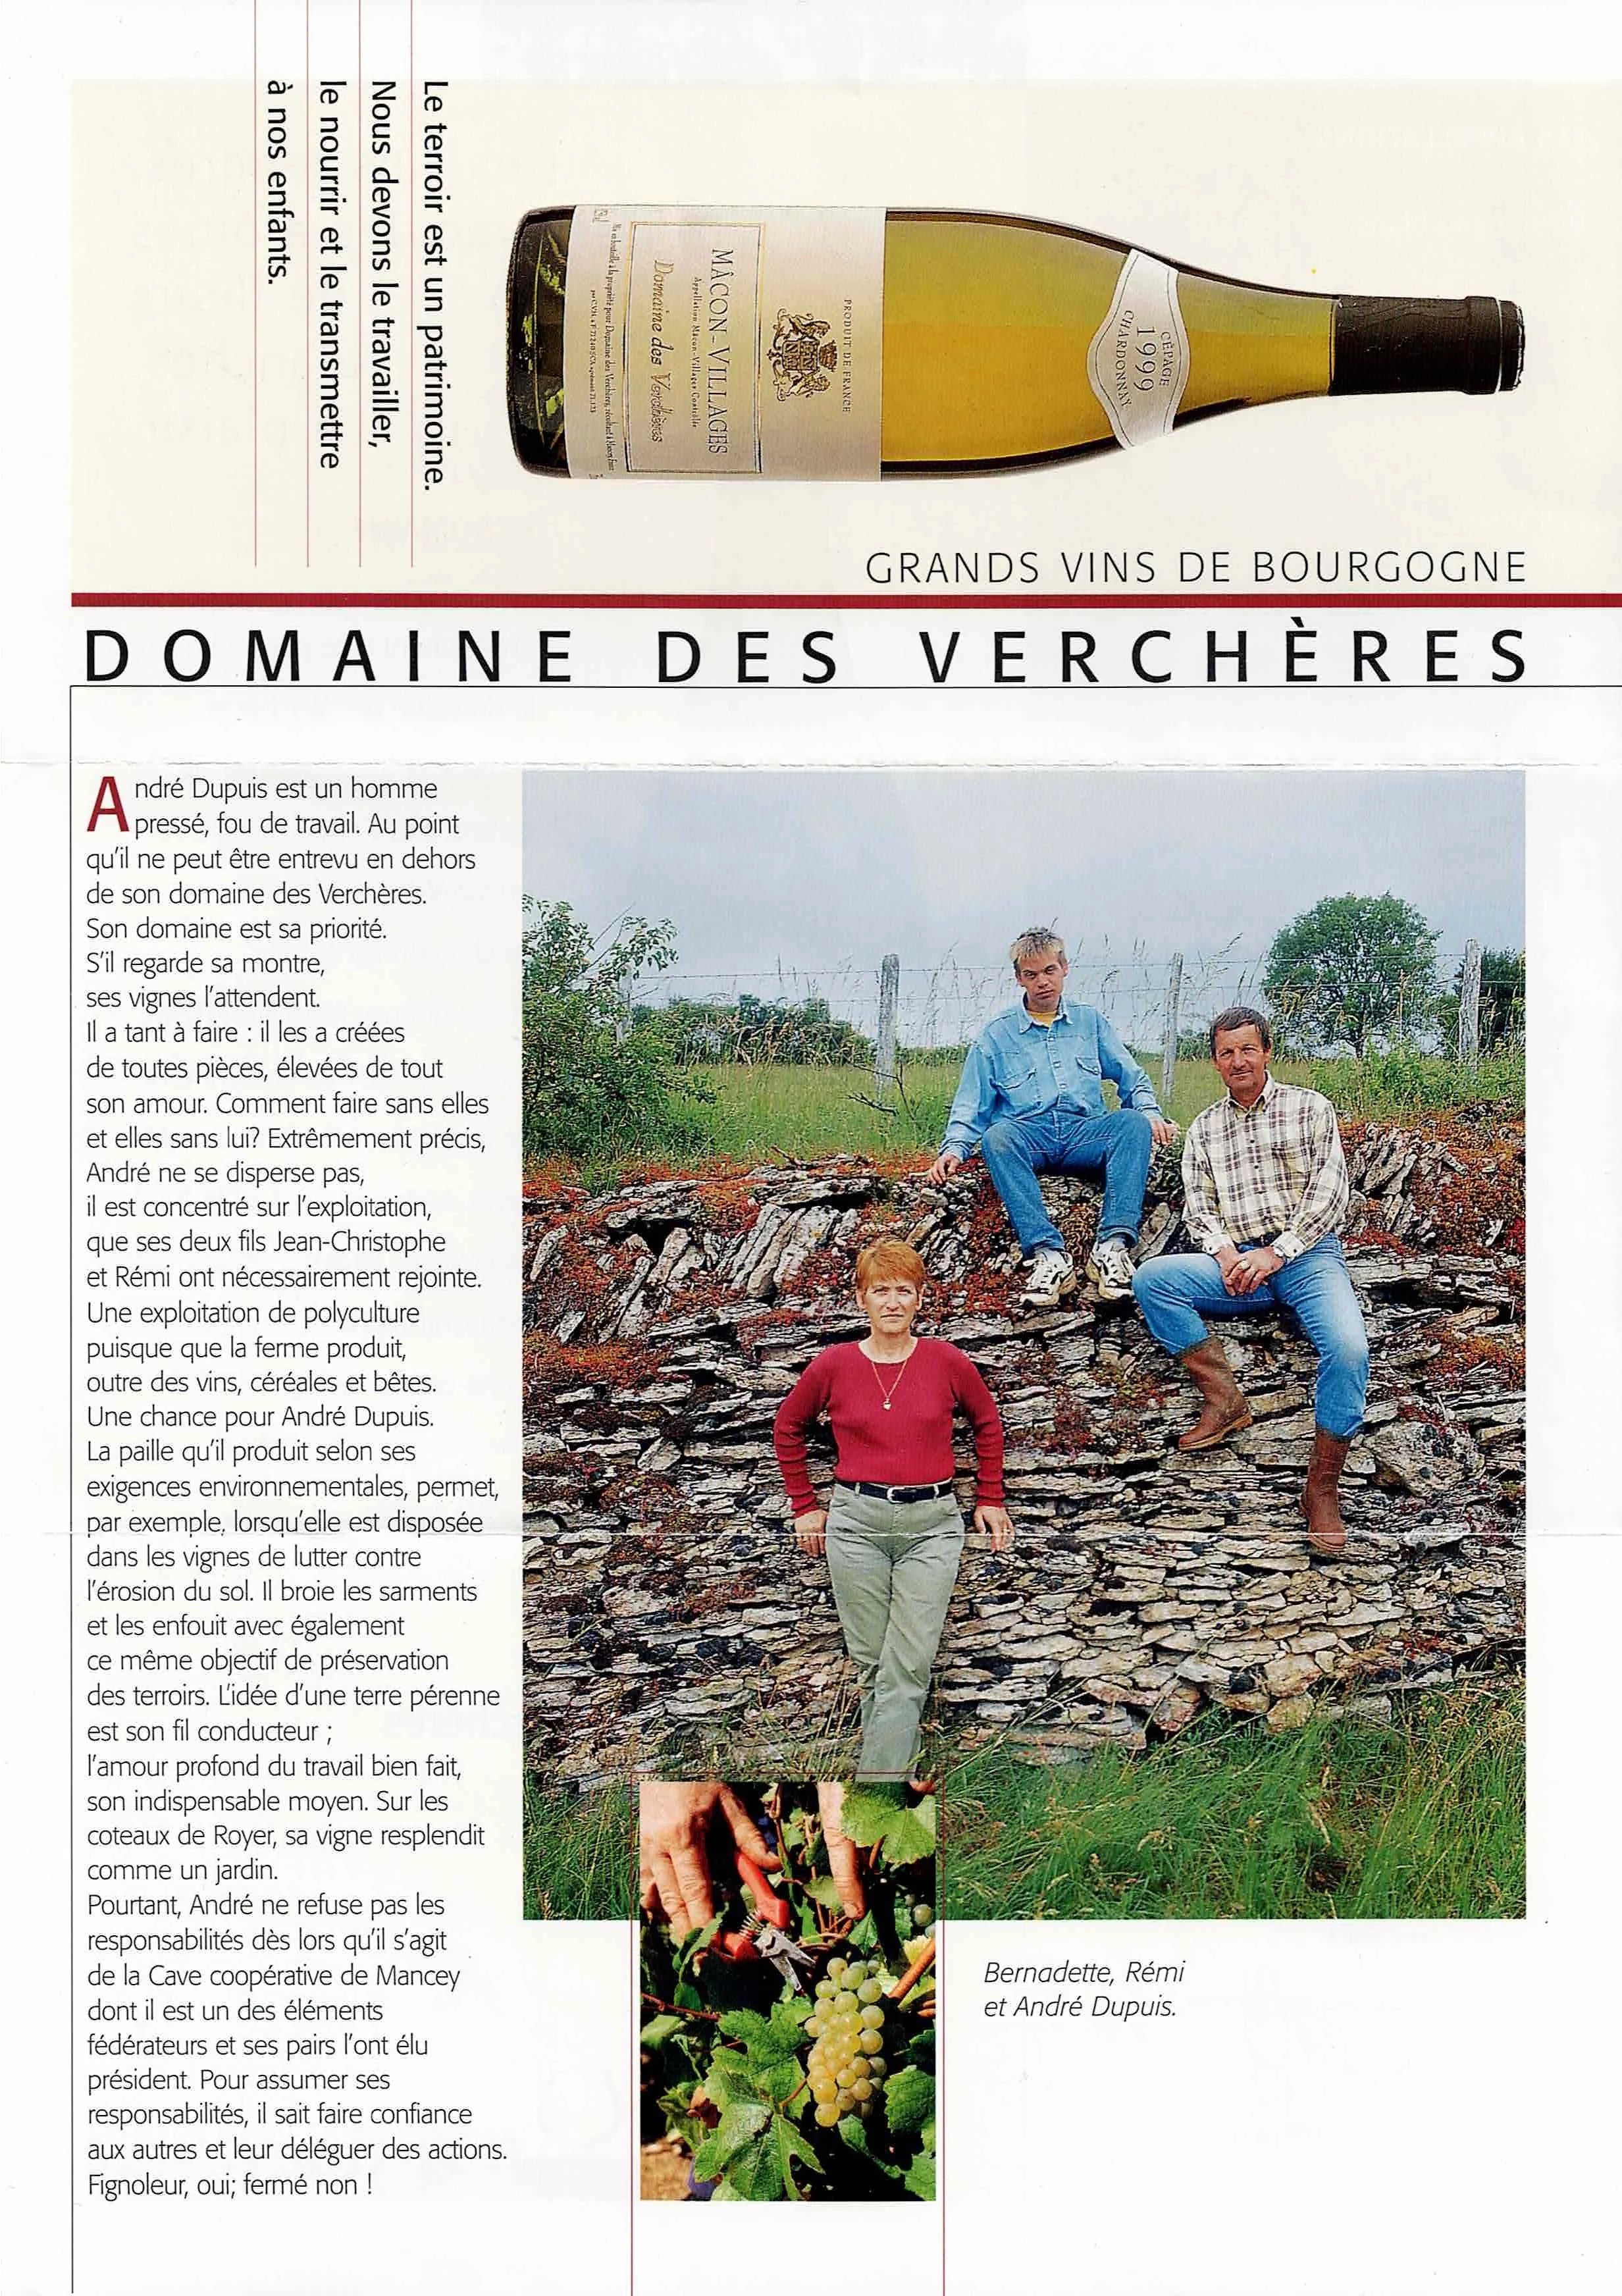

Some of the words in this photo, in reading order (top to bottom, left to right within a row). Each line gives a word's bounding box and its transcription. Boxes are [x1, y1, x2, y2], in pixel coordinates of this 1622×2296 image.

[267, 80, 294, 95] à
[320, 81, 348, 105] le
[424, 82, 448, 112] Le
[267, 108, 286, 159] nos
[372, 81, 396, 155] Nous
[320, 117, 347, 216] nourrir
[424, 122, 451, 213] terroir
[267, 171, 295, 284] enfants.
[372, 167, 400, 271] devons
[320, 227, 343, 255] et
[424, 224, 448, 266] est
[320, 266, 348, 289] le
[372, 283, 400, 306] le
[424, 278, 443, 311] un
[651, 260, 674, 332] Domaine
[691, 277, 702, 321] Appellation
[843, 300, 851, 348] PRODUIT
[604, 326, 614, 358] Domaine
[650, 337, 673, 366] des
[706, 248, 733, 454] MÂCON-VILLAGES
[843, 352, 850, 366] DE
[1115, 310, 1134, 407] CHARDONNAY
[1133, 326, 1156, 391] 1999
[1158, 331, 1174, 387] CÉPAGE
[320, 300, 344, 469] transmettre
[368, 317, 400, 448] travailler,
[842, 371, 850, 412] FRANCE
[416, 325, 451, 490] patrimoine.
[867, 552, 1037, 583] GRANDS
[1061, 552, 1154, 583] VINS
[1180, 552, 1229, 582] DE
[1255, 551, 1525, 582] BOURGOGNE
[87, 629, 571, 682] DOMAINE
[658, 631, 835, 683] DES
[920, 617, 1525, 683] VERCHÈRES
[193, 776, 268, 805] Dupuis
[275, 779, 307, 798] est
[315, 782, 342, 799] un
[352, 775, 438, 799] homme
[135, 812, 209, 841] pressé,
[216, 810, 251, 834] fou
[260, 810, 288, 834] de
[295, 810, 360, 834] travail.
[368, 812, 396, 835] Au
[405, 812, 460, 841] point
[86, 881, 114, 904] de
[122, 888, 160, 904] son
[169, 881, 265, 904] domaine
[273, 881, 311, 904] des
[318, 881, 427, 905] Verchères.
[86, 991, 122, 1008] ses
[128, 985, 196, 1014] vignes
[205, 984, 320, 1008] l'attendent.
[86, 1097, 124, 1114] son
[134, 1097, 207, 1114] amour.
[216, 1092, 327, 1114] Comment
[332, 1091, 378, 1114] faire
[386, 1097, 434, 1114] sans
[442, 1090, 489, 1114] elles
[86, 1160, 151, 1183] André
[159, 1167, 186, 1183] ne
[194, 1166, 219, 1183] se
[226, 1160, 315, 1189] disperse
[323, 1167, 364, 1189] pas,
[86, 1236, 128, 1258] que
[136, 1236, 172, 1252] ses
[180, 1228, 232, 1252] deux
[238, 1228, 266, 1252] fils
[273, 1228, 446, 1258] Jean-Christophe
[88, 1301, 132, 1324] Une
[140, 1299, 259, 1330] exploitation
[268, 1299, 296, 1323] de
[305, 1299, 420, 1330] polyculture
[88, 1405, 132, 1427] Une
[140, 1403, 217, 1427] chance
[225, 1411, 275, 1433] pour
[281, 1403, 346, 1426] André
[355, 1405, 434, 1433] Dupuis.
[87, 1474, 191, 1504] exigences
[199, 1473, 408, 1501] environnementales,
[417, 1477, 499, 1503] permet,
[87, 1544, 138, 1567] dans
[147, 1544, 176, 1567] les
[182, 1544, 250, 1574] vignes
[258, 1544, 286, 1567] de
[294, 1544, 348, 1567] lutter
[355, 1548, 421, 1567] contre
[87, 1654, 112, 1671] ce
[120, 1649, 193, 1671] même
[200, 1648, 278, 1677] objectif
[284, 1647, 312, 1671] de
[321, 1648, 448, 1677] préservation
[88, 1753, 169, 1777] l'amour
[176, 1753, 259, 1783] profond
[268, 1753, 296, 1777] du
[303, 1753, 363, 1777] travail
[372, 1753, 417, 1777] bien
[425, 1754, 461, 1781] fait,
[88, 1864, 172, 1881] comme
[180, 1864, 207, 1881] un
[215, 1857, 278, 1886] jardin.
[88, 1962, 115, 1986] de
[124, 1962, 140, 1986] la
[149, 1964, 202, 1986] Cave
[210, 1964, 332, 1993] coopérative
[340, 1962, 368, 1986] de
[377, 1964, 461, 1993] Mancey
[985, 1960, 1114, 1986] Bernadette,
[1126, 1960, 1186, 1982] Rémi
[985, 1998, 1007, 2016] et
[1013, 1994, 1082, 2016] André
[1092, 1995, 1175, 2022] Dupuis.
[87, 2032, 207, 2056] fédérateurs
[215, 2036, 236, 2056] et
[243, 2039, 278, 2056] ses
[287, 2033, 336, 2062] pairs
[344, 2032, 389, 2056] l'ont
[396, 2032, 428, 2056] élu
[88, 2143, 125, 2160] aux
[132, 2140, 197, 2160] autres
[205, 2140, 226, 2160] et
[234, 2136, 274, 2160] leur
[280, 2135, 375, 2166] déléguer
[382, 2136, 421, 2160] des
[428, 2137, 507, 2160] actions.
[89, 2172, 188, 2202] Fignoleur,
[197, 2172, 236, 2199] oui;
[242, 2172, 308, 2195] fermé
[316, 2179, 357, 2195] non
